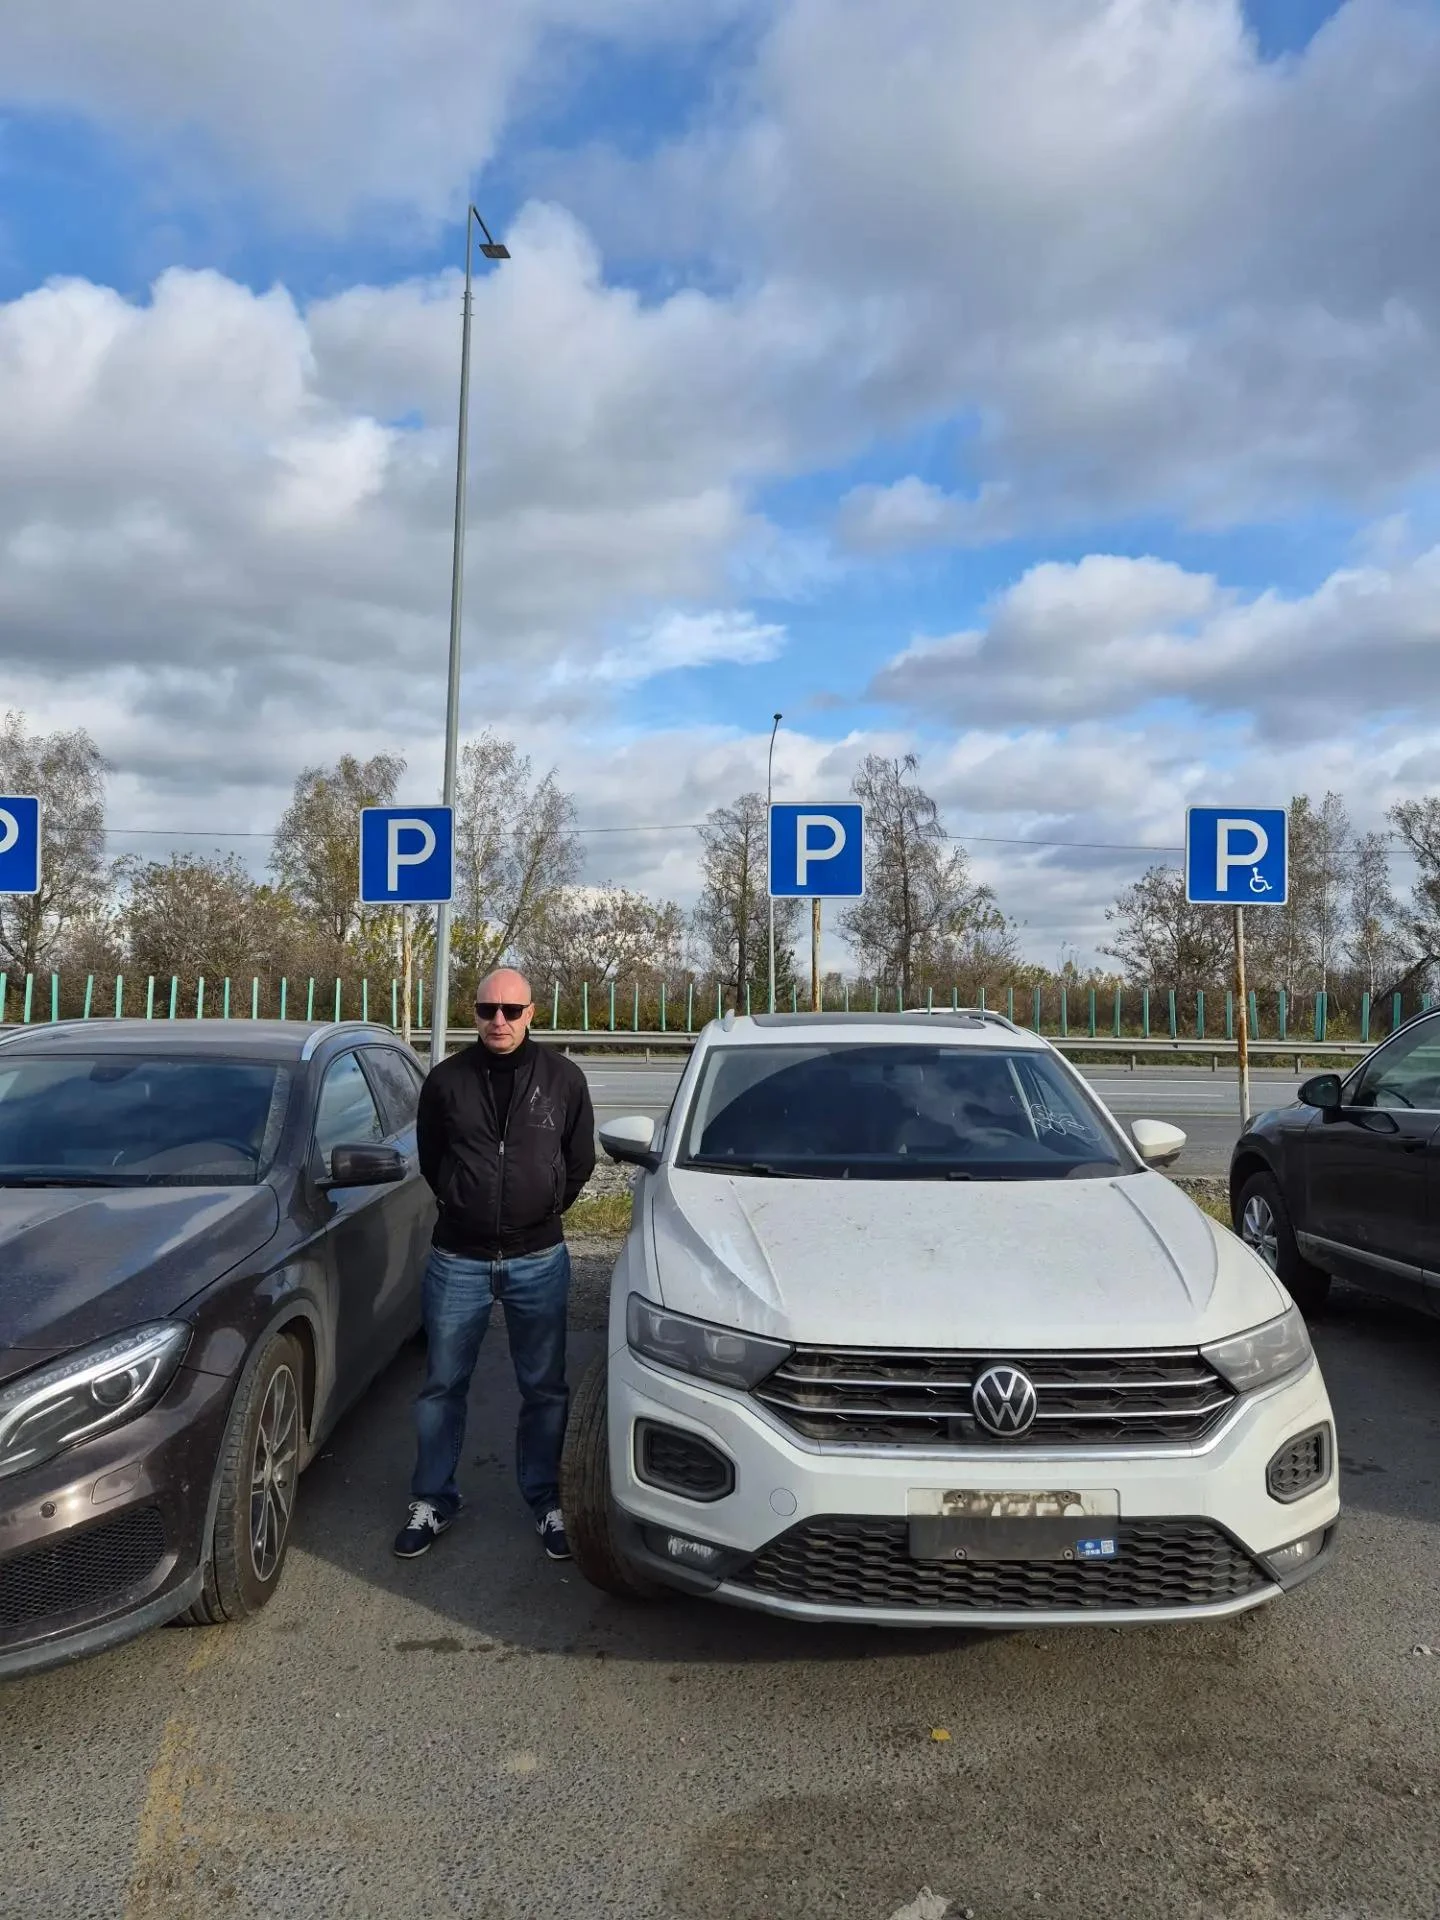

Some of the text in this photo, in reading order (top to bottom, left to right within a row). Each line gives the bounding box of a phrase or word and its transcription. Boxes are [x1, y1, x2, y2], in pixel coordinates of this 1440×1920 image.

[387, 818, 436, 892] P
[796, 814, 846, 886] P
[1216, 818, 1269, 892] P
